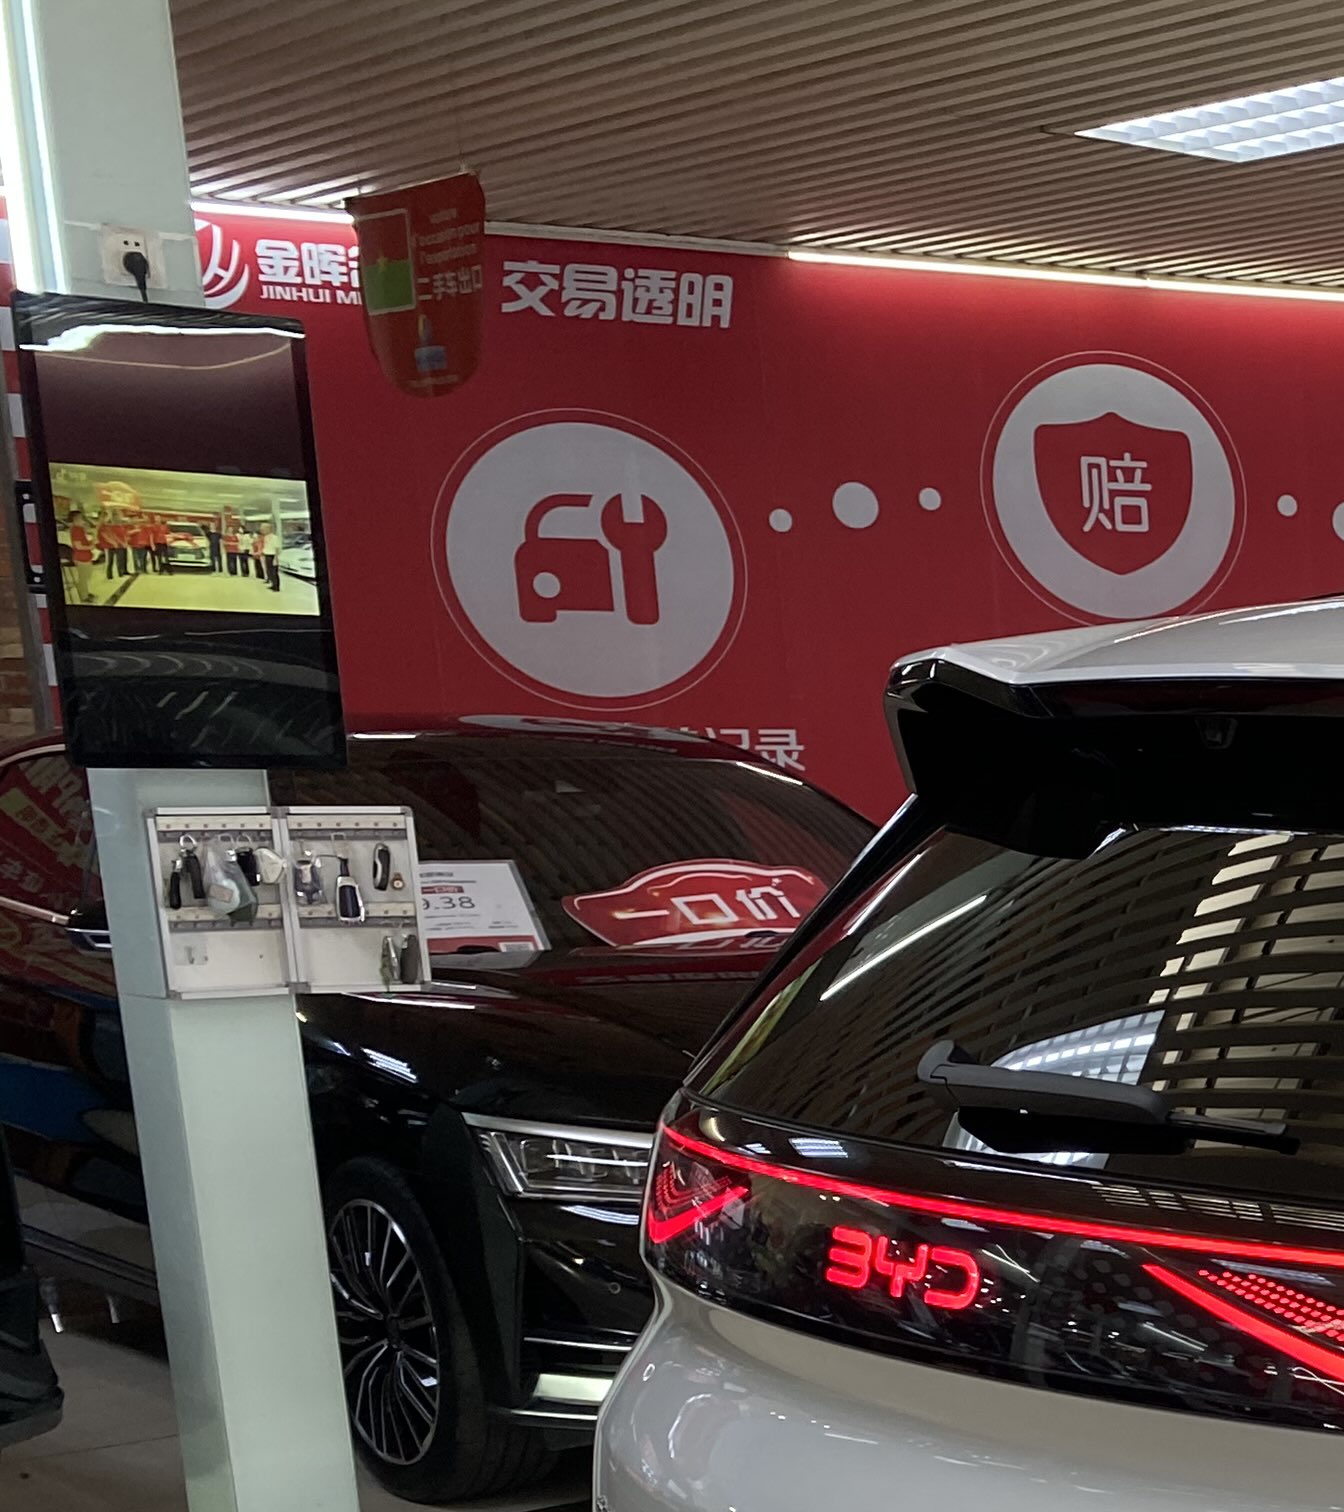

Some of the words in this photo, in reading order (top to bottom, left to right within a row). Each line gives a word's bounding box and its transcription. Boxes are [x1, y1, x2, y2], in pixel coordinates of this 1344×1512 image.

[260, 285, 331, 303] JINHUI
[501, 260, 733, 329] 交易透明
[1080, 452, 1152, 532] 赔
[613, 881, 801, 926] 一口价
[825, 1226, 981, 1310] BYD
